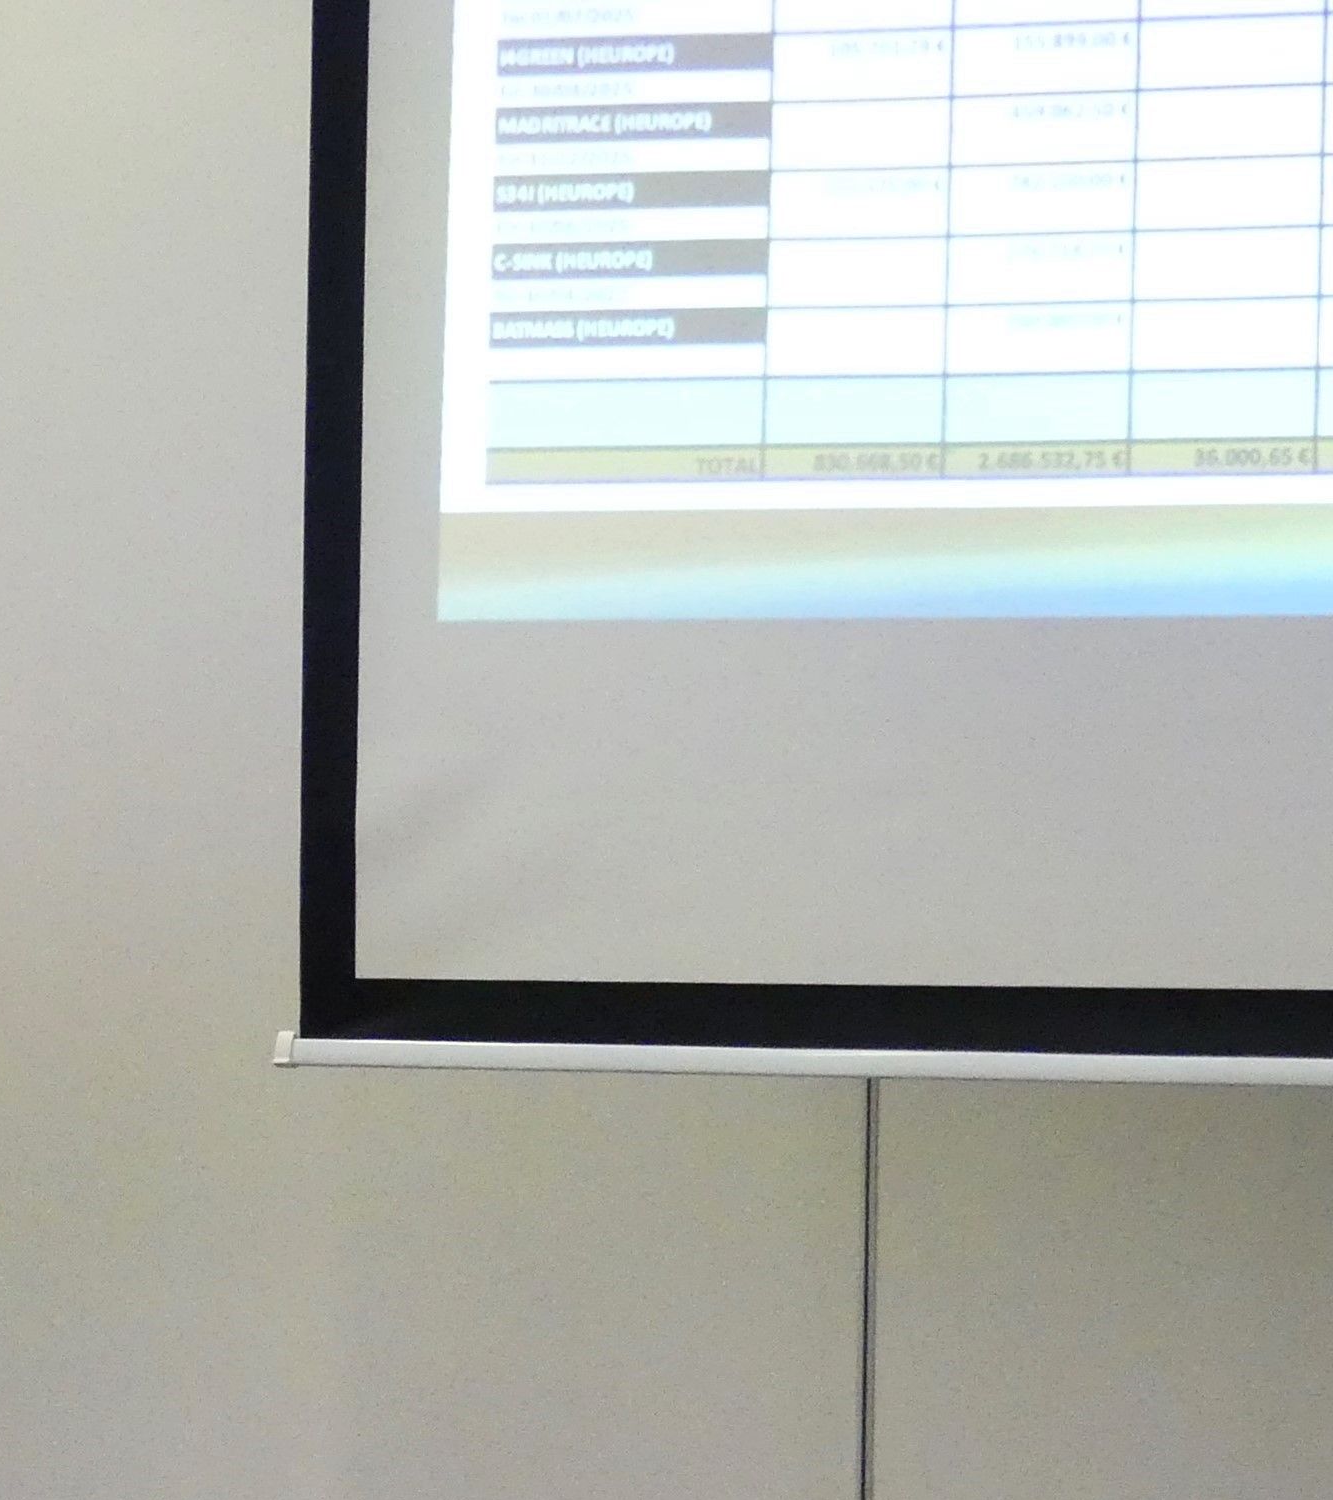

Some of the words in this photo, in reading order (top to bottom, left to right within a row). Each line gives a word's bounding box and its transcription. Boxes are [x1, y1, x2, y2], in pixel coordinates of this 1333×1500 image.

[696, 456, 759, 476] TOTAL
[925, 451, 943, 473] €
[1111, 450, 1126, 470] €
[1298, 446, 1315, 466] €
